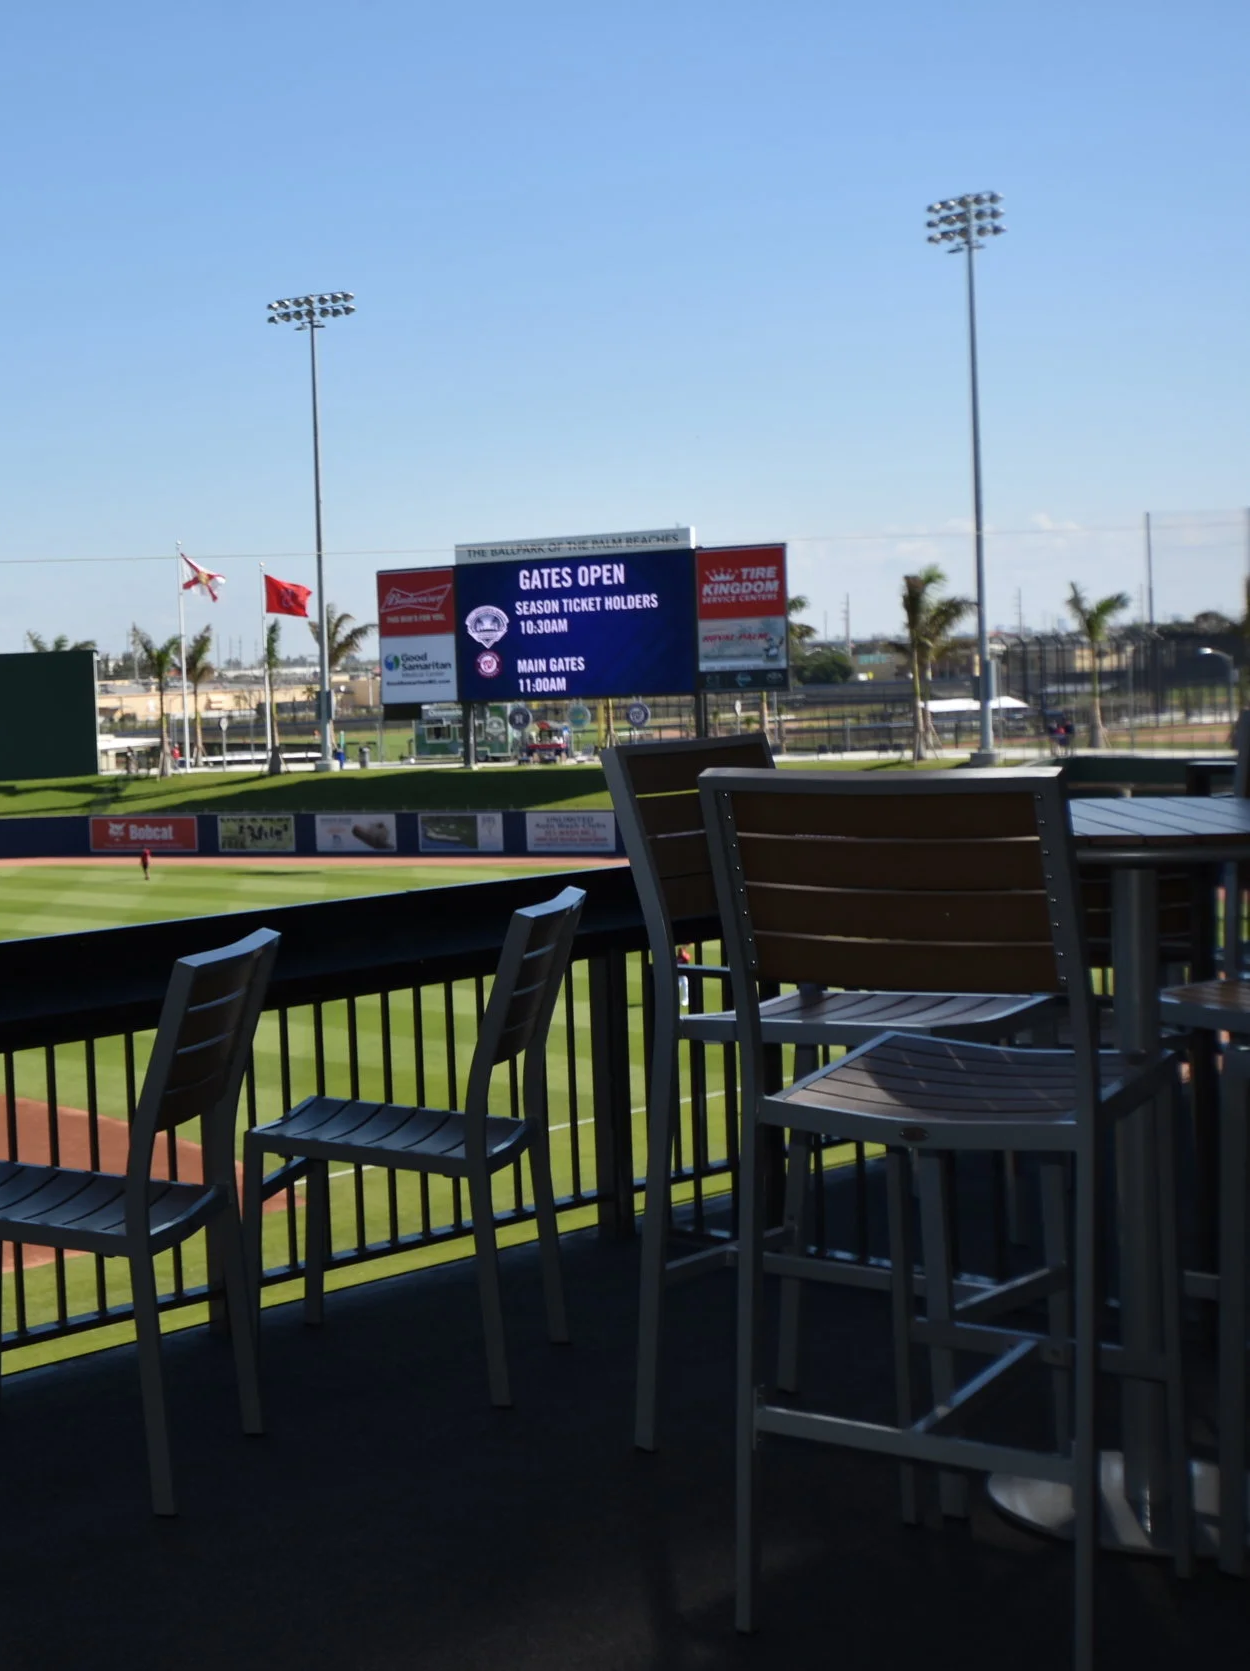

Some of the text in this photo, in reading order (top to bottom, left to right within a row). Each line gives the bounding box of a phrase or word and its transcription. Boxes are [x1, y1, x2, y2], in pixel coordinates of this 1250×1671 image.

[467, 533, 679, 558] THE BALLPARK OF THE PALM BEACHES
[519, 562, 626, 591] GATES OPEN
[740, 566, 778, 580] TIRE
[702, 580, 780, 597] KINGDOM
[515, 599, 560, 616] SEASON
[562, 596, 602, 613] TICKET
[604, 594, 659, 611] HOLDERS
[520, 618, 568, 635] 10:30AM
[401, 652, 428, 662] Good
[517, 656, 585, 673] MAIN GATES
[401, 661, 452, 671] Samaritan
[518, 676, 567, 693] 11:00AM
[129, 824, 174, 841] Bobcat
